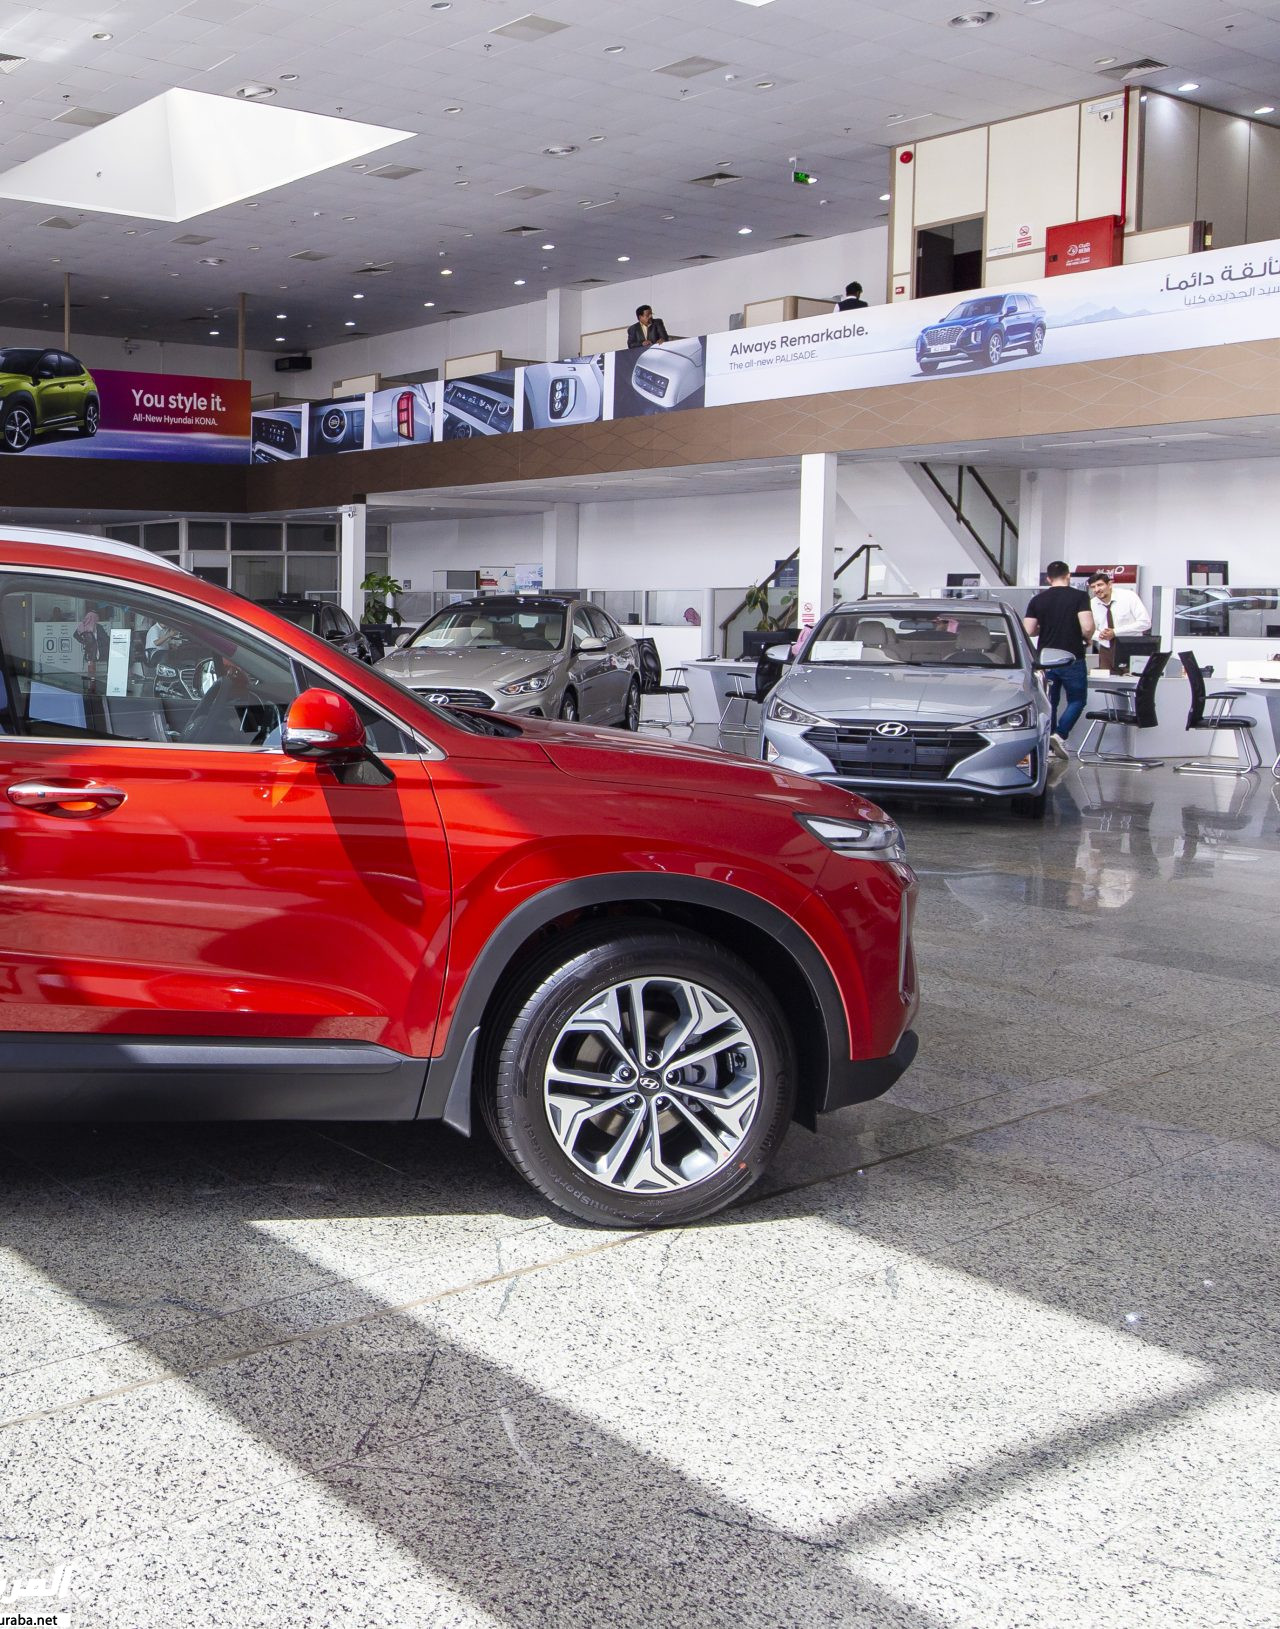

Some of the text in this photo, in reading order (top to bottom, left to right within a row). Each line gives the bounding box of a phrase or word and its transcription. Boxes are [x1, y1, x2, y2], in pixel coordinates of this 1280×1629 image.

[730, 324, 869, 356] Always Remarkable.
[729, 350, 818, 370] The all-new PALISADE.
[131, 388, 226, 413] You style it.
[132, 413, 218, 426] All-New Hyundai KONA.
